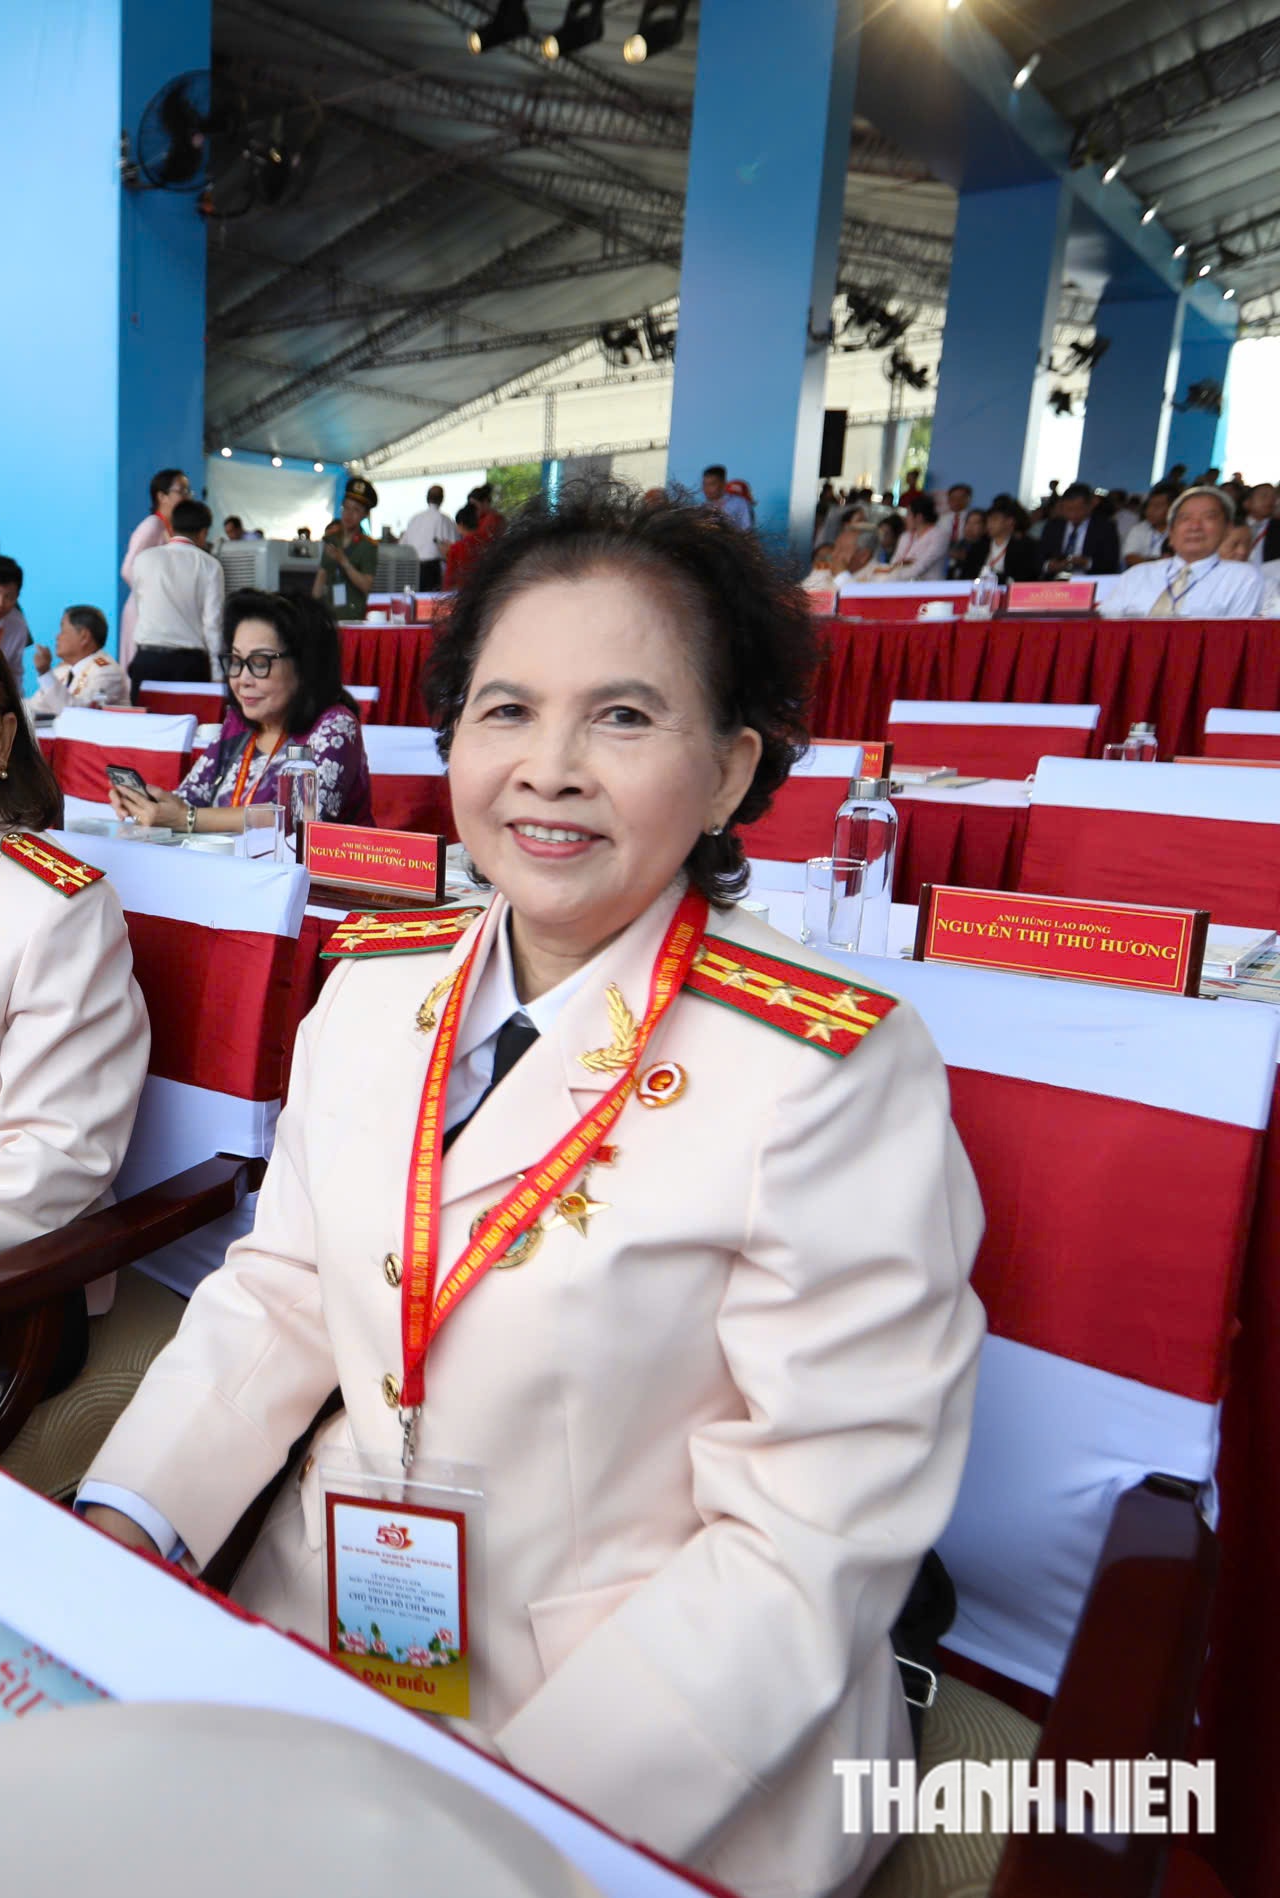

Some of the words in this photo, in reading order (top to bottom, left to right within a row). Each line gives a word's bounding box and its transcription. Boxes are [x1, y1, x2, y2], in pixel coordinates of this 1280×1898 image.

[310, 845, 346, 859] NGUYỄN
[349, 851, 364, 864] THỊ
[366, 853, 406, 867] PHƯƠNG
[408, 860, 435, 871] DUNG
[997, 914, 1020, 924] ANH
[1022, 915, 1052, 928] HÙNG
[1054, 920, 1077, 931] LAO
[1079, 923, 1111, 934] ĐỘNG
[936, 918, 1012, 939] NGUYỄN
[1017, 928, 1050, 948] THỊ
[1054, 933, 1095, 950] THU
[1100, 938, 1177, 960] HƯƠNG
[397, 1673, 436, 1696] BIỂU
